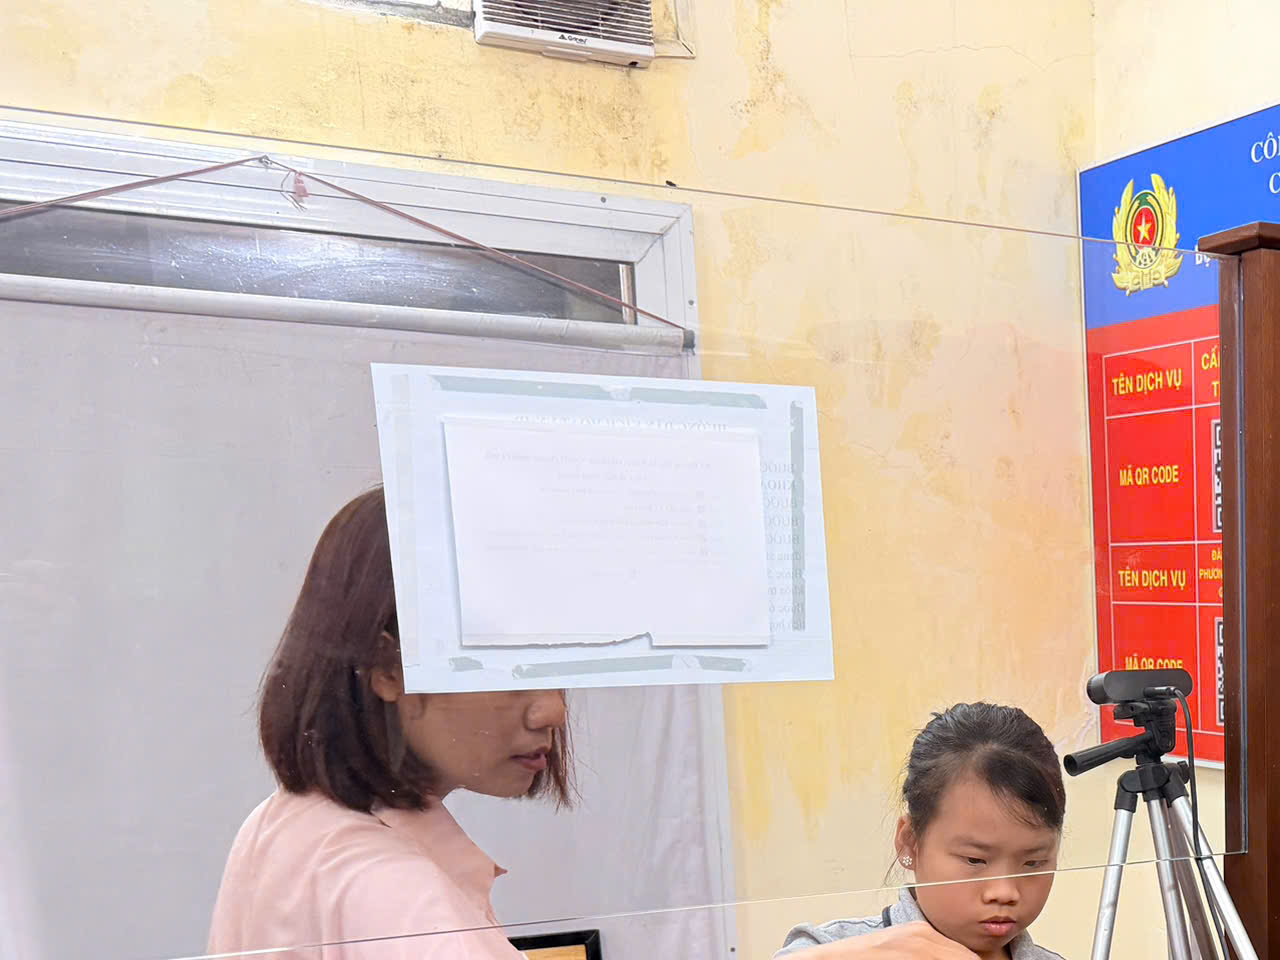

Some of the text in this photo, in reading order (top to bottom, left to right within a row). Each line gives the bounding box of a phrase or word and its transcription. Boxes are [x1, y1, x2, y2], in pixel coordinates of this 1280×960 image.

[1112, 368, 1183, 396] TÊN DỊCH VỤ
[1119, 464, 1180, 487] MÃ QR CODE
[1118, 565, 1186, 590] TÊN DỊCH VỤ
